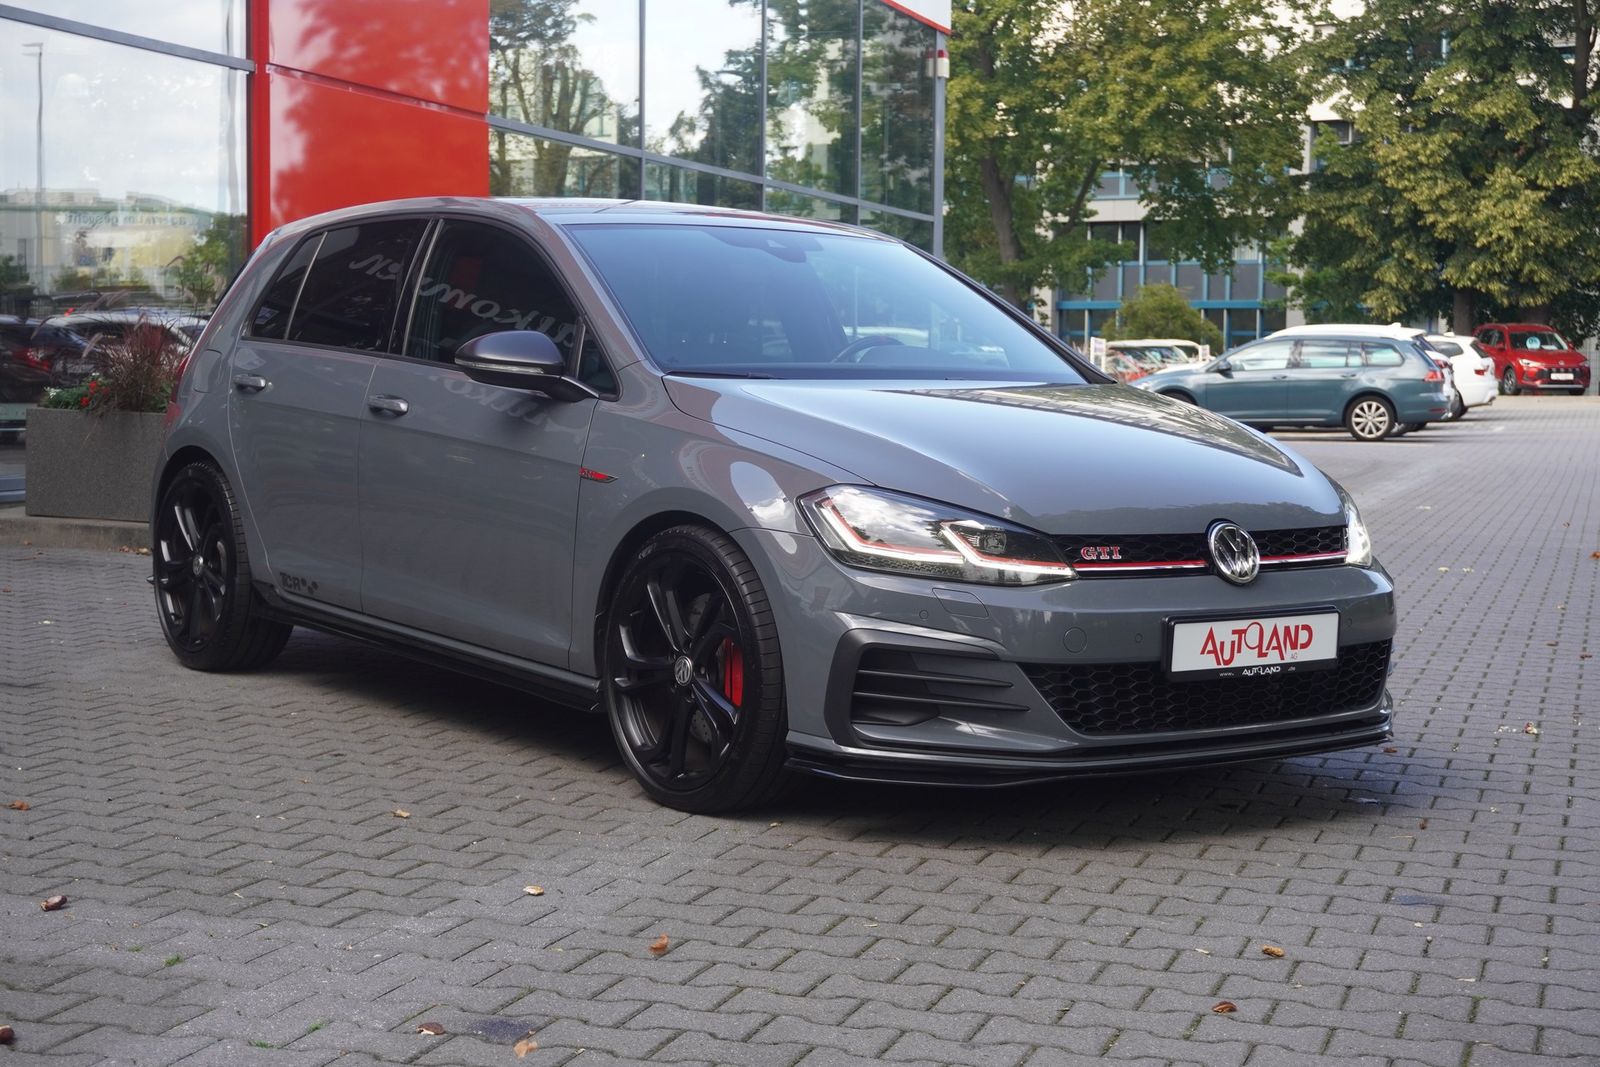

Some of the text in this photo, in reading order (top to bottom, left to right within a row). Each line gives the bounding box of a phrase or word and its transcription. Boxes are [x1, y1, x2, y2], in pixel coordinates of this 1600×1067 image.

[1080, 545, 1122, 560] GTI
[279, 571, 301, 591] TCR
[1199, 621, 1314, 666] AUTOLAND
[1241, 666, 1281, 676] AUTOLAND
